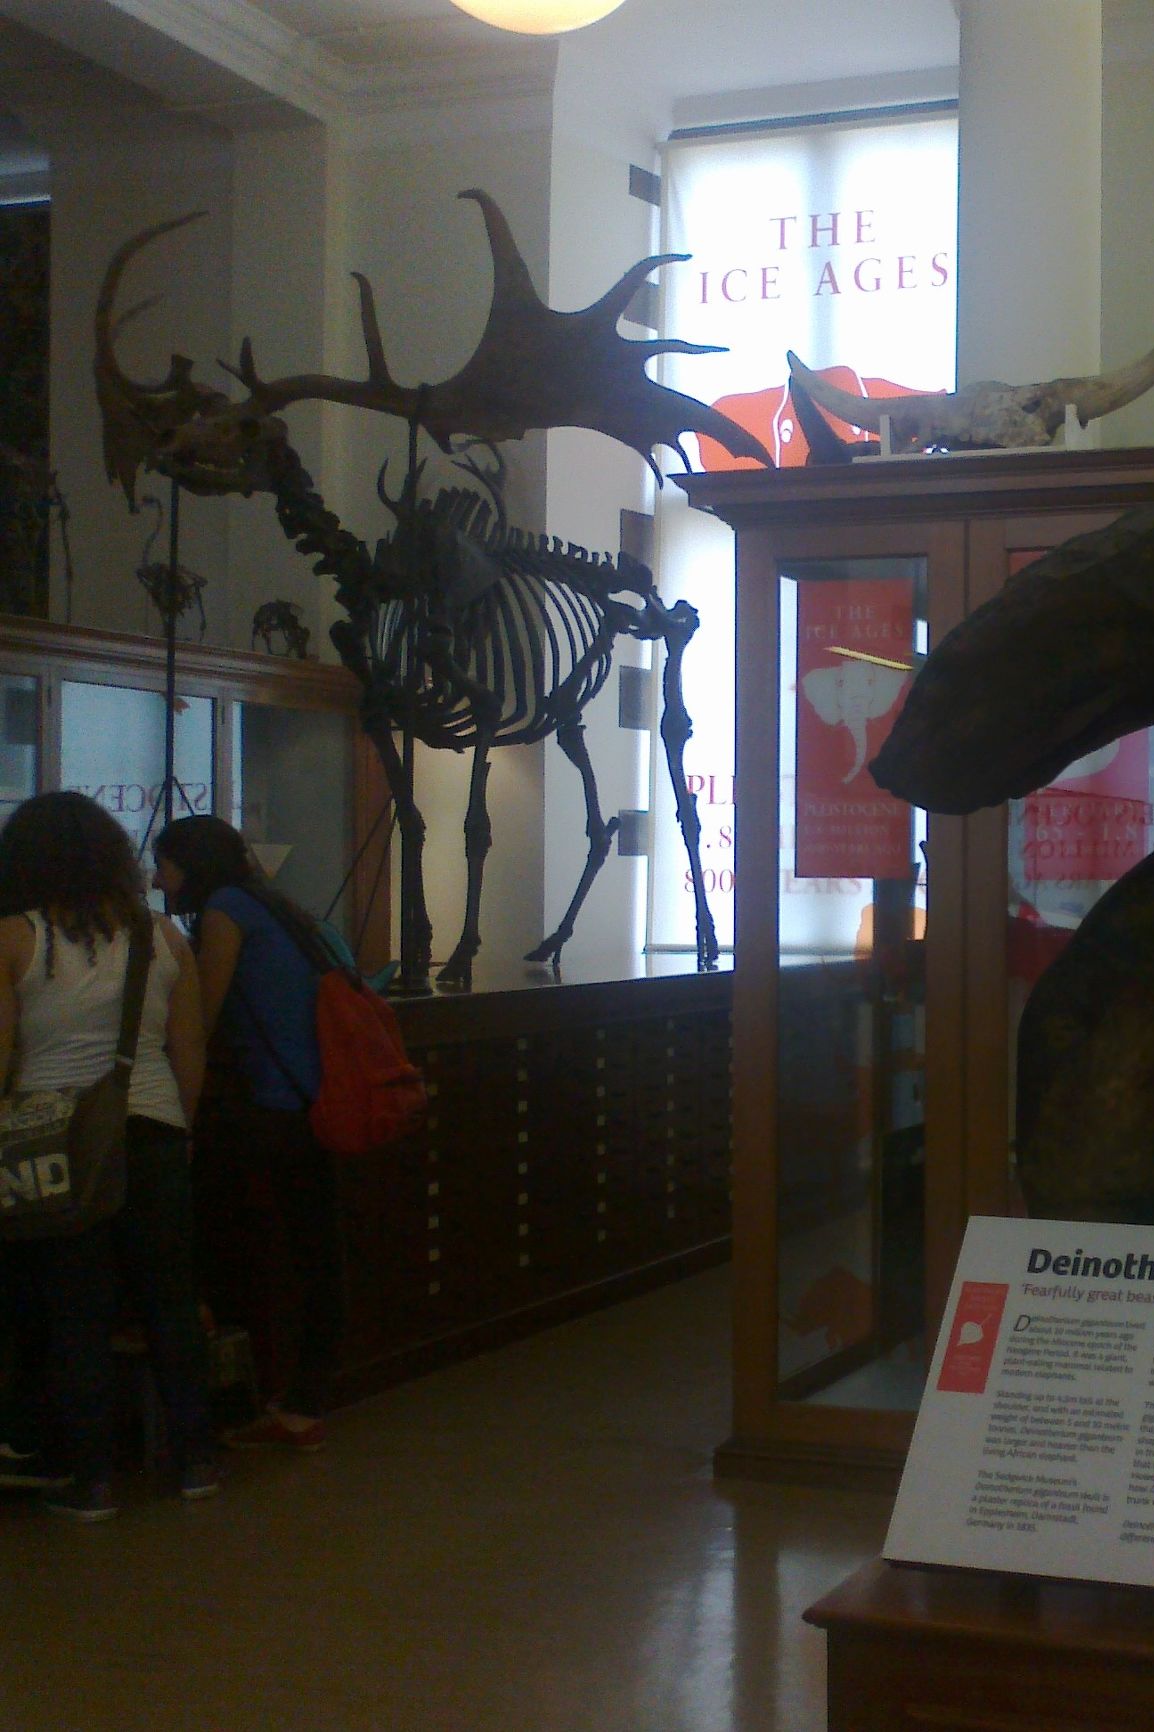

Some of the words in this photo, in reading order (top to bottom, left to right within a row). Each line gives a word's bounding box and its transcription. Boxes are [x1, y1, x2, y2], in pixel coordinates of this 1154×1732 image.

[769, 210, 876, 250] THE
[700, 266, 781, 304] ICE
[813, 252, 949, 296] AGES
[1088, 1286, 1123, 1304] great
